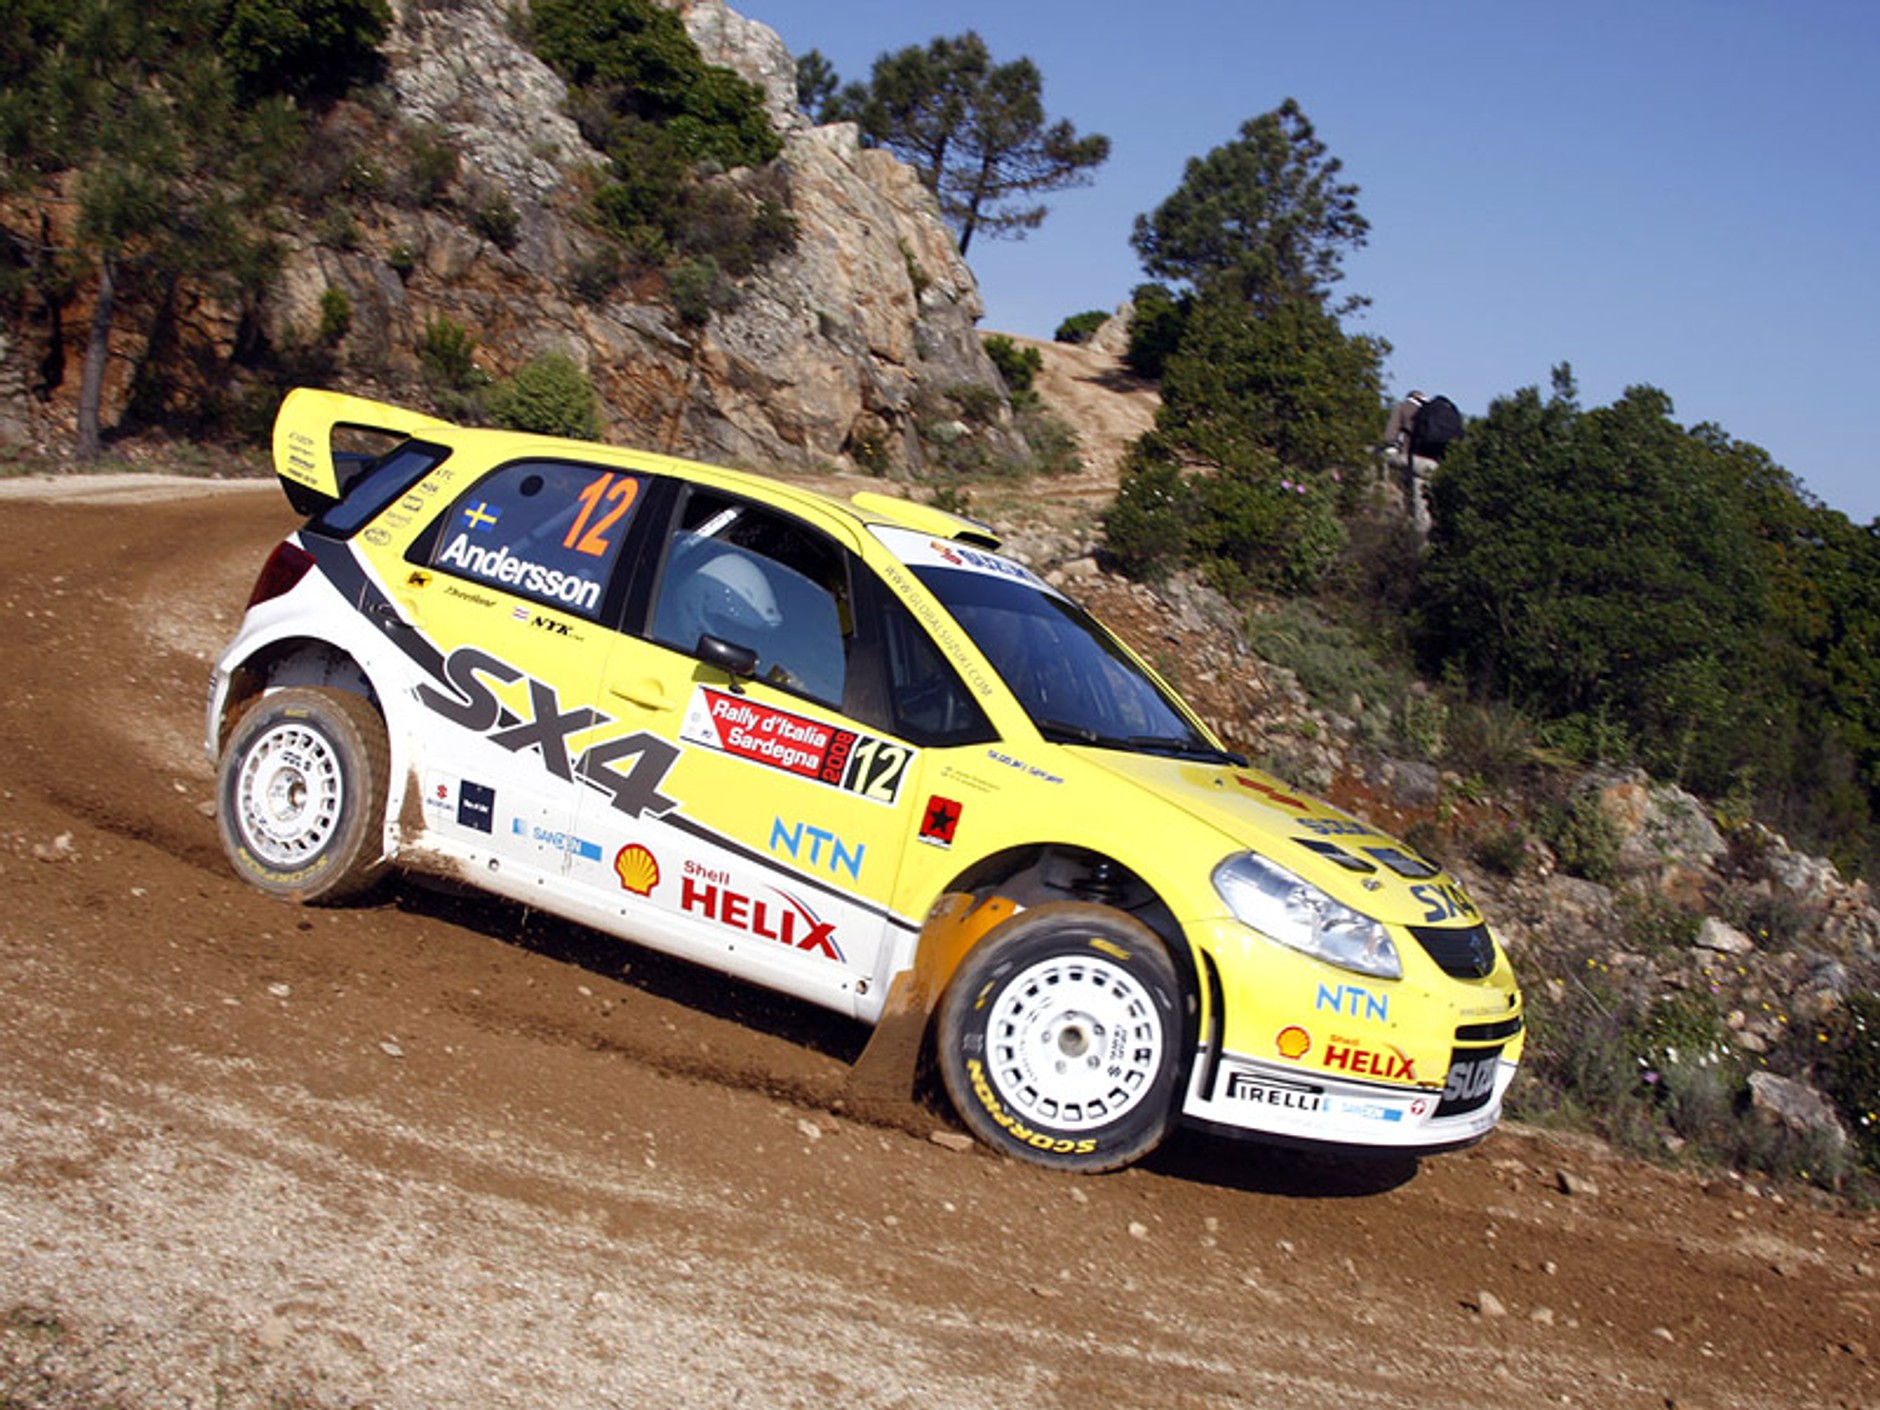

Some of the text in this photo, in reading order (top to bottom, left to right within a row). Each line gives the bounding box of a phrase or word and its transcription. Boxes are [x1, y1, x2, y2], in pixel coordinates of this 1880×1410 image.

[563, 472, 639, 557] 12
[440, 533, 601, 609] Andersson
[415, 647, 679, 820] SX4
[712, 698, 827, 748] Rally d'Italia
[727, 726, 820, 771] Sardegna
[822, 731, 856, 785] 2008
[852, 739, 907, 805] 12
[683, 859, 730, 885] Shell
[769, 816, 866, 880] NTN
[680, 876, 843, 962] HELIX
[1315, 981, 1389, 1022] NTN
[1226, 1071, 1321, 1111] PIRELLI
[1322, 1044, 1417, 1080] HELIX
[966, 1058, 1097, 1154] SCORPION
